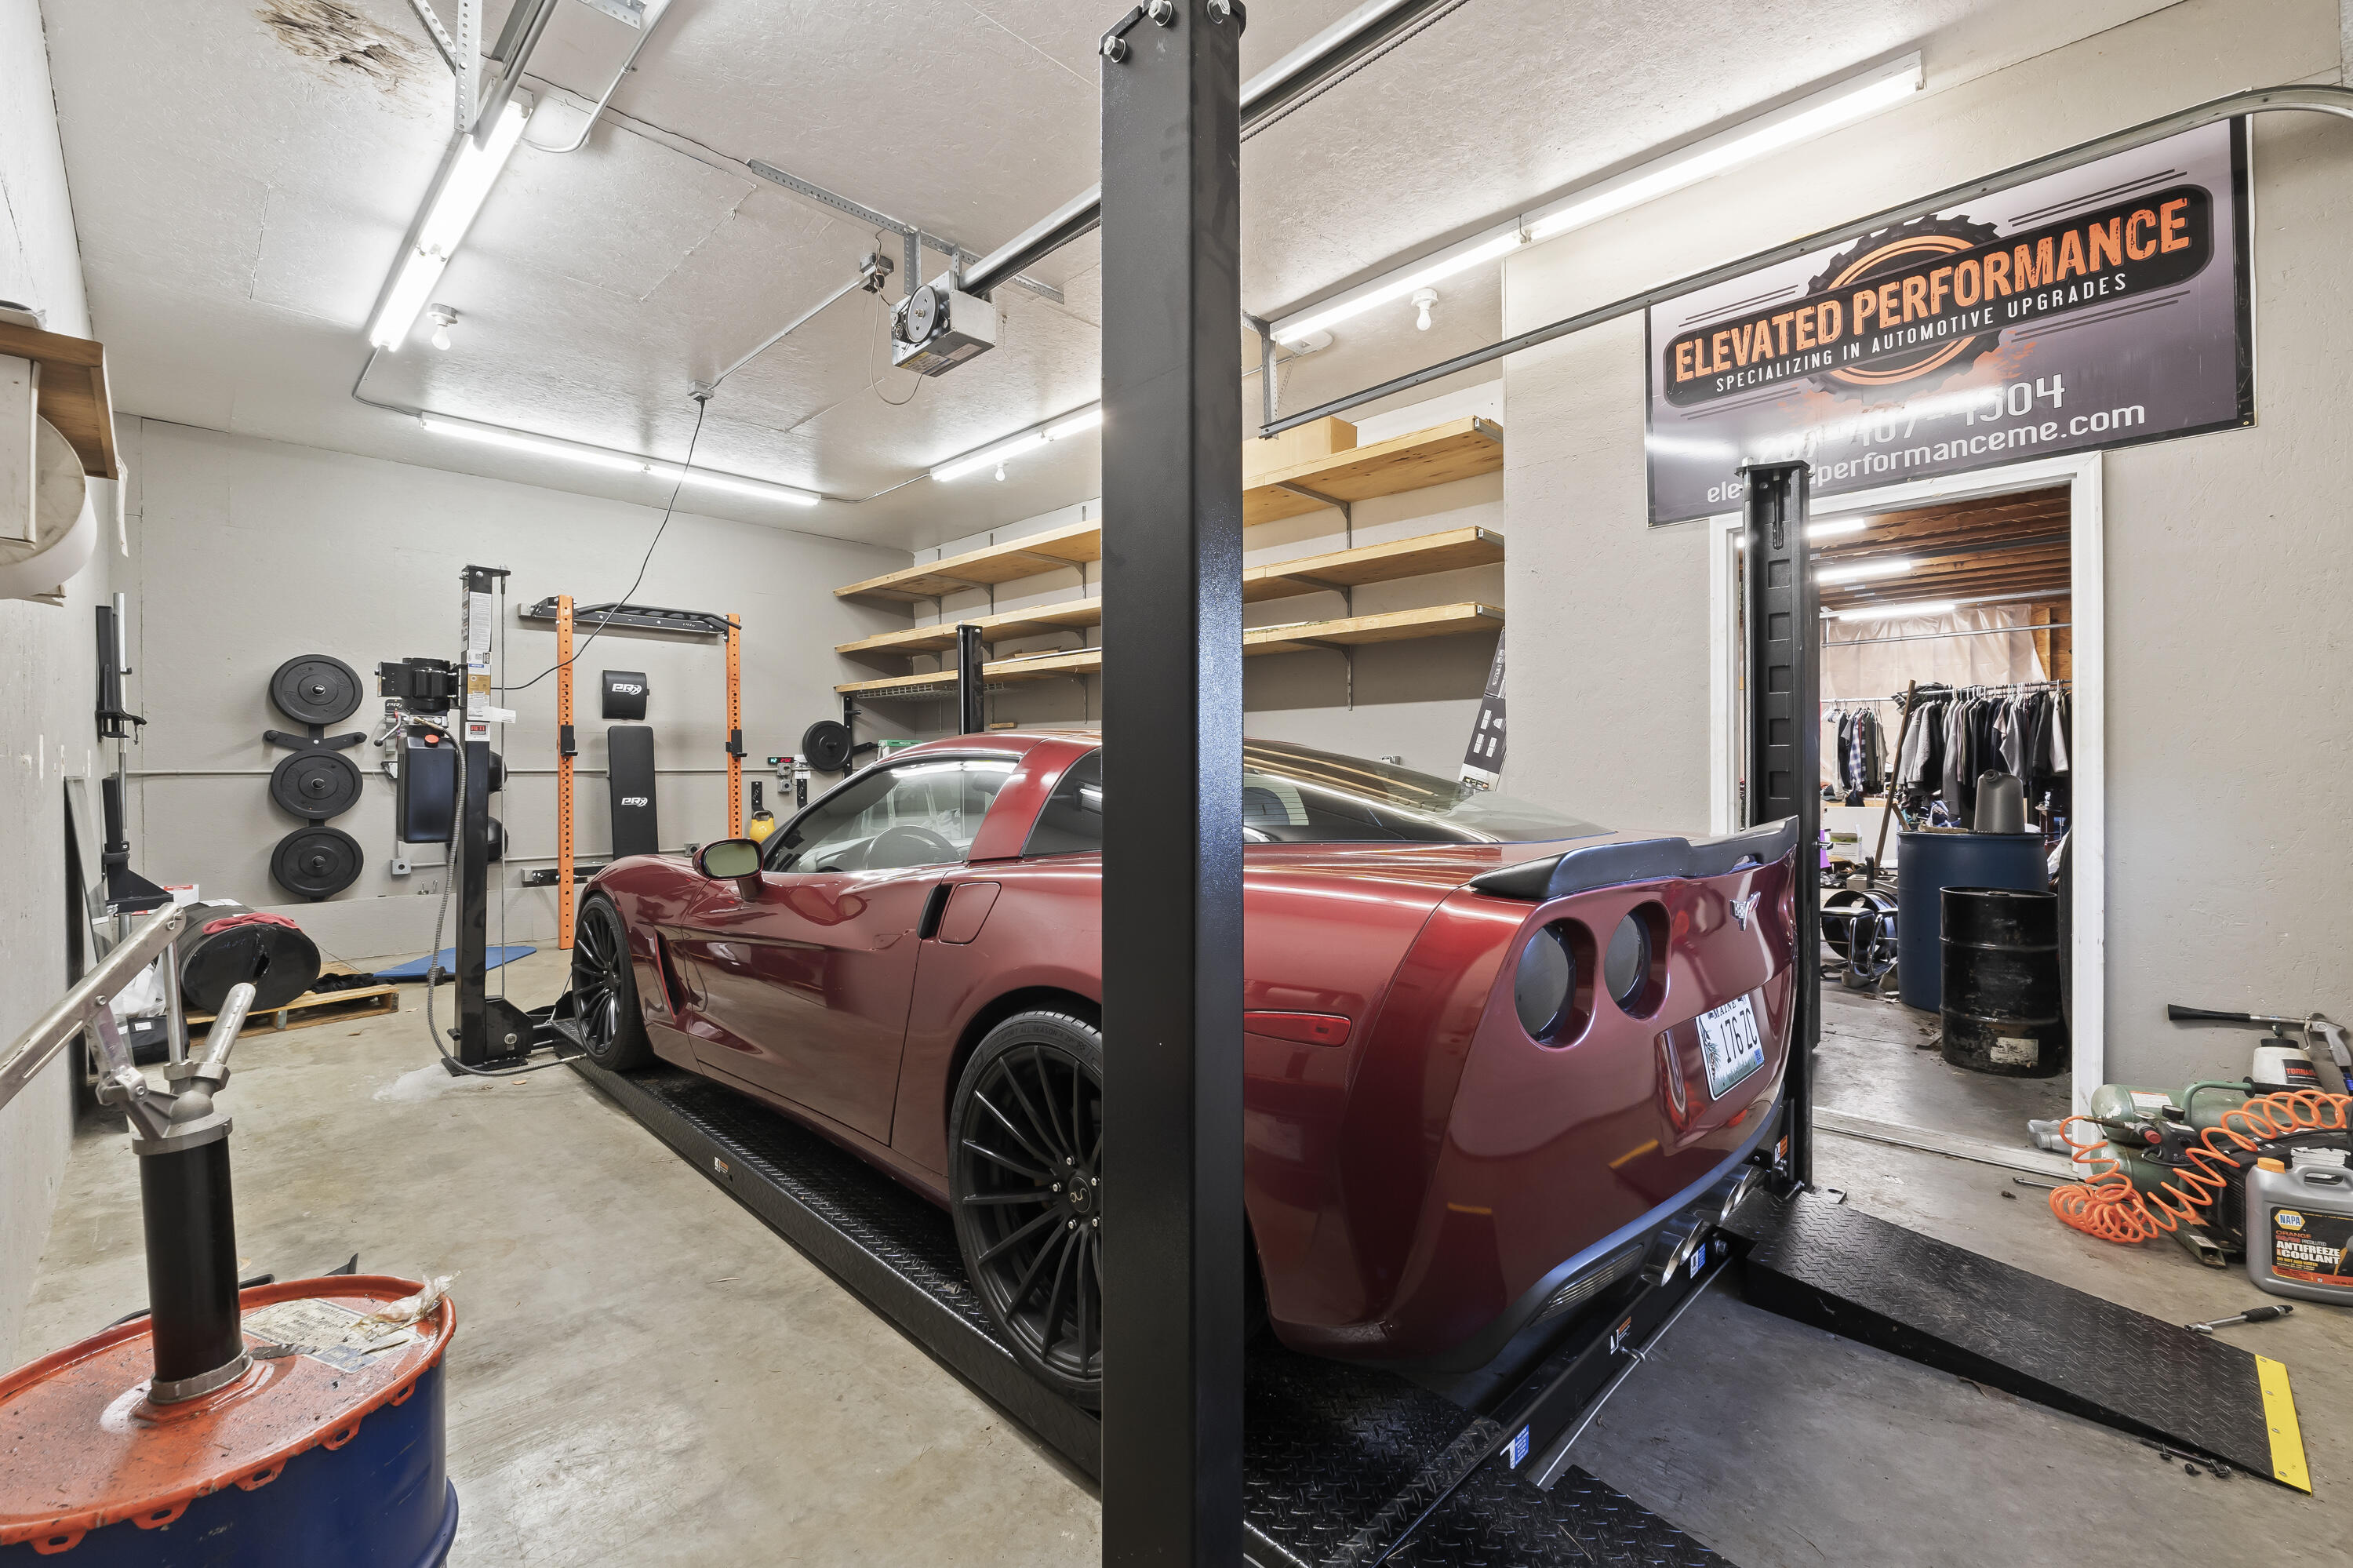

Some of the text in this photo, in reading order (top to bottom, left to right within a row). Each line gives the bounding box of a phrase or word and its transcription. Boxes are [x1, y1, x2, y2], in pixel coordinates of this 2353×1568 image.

[1675, 198, 2191, 383] ELEVATED PERFORMANCE
[1716, 273, 2126, 392] SPECIALIZING IN AUTOMOTIVE UPGRADES
[1707, 405, 2145, 503] eleperformanceme.com
[1713, 1000, 1737, 1019] MAINE
[2279, 1214, 2301, 1225] NAPA
[2275, 1230, 2312, 1239] ORANGE
[2276, 1240, 2340, 1257] ANTIFREEZE
[2281, 1249, 2340, 1264] COOLANT
